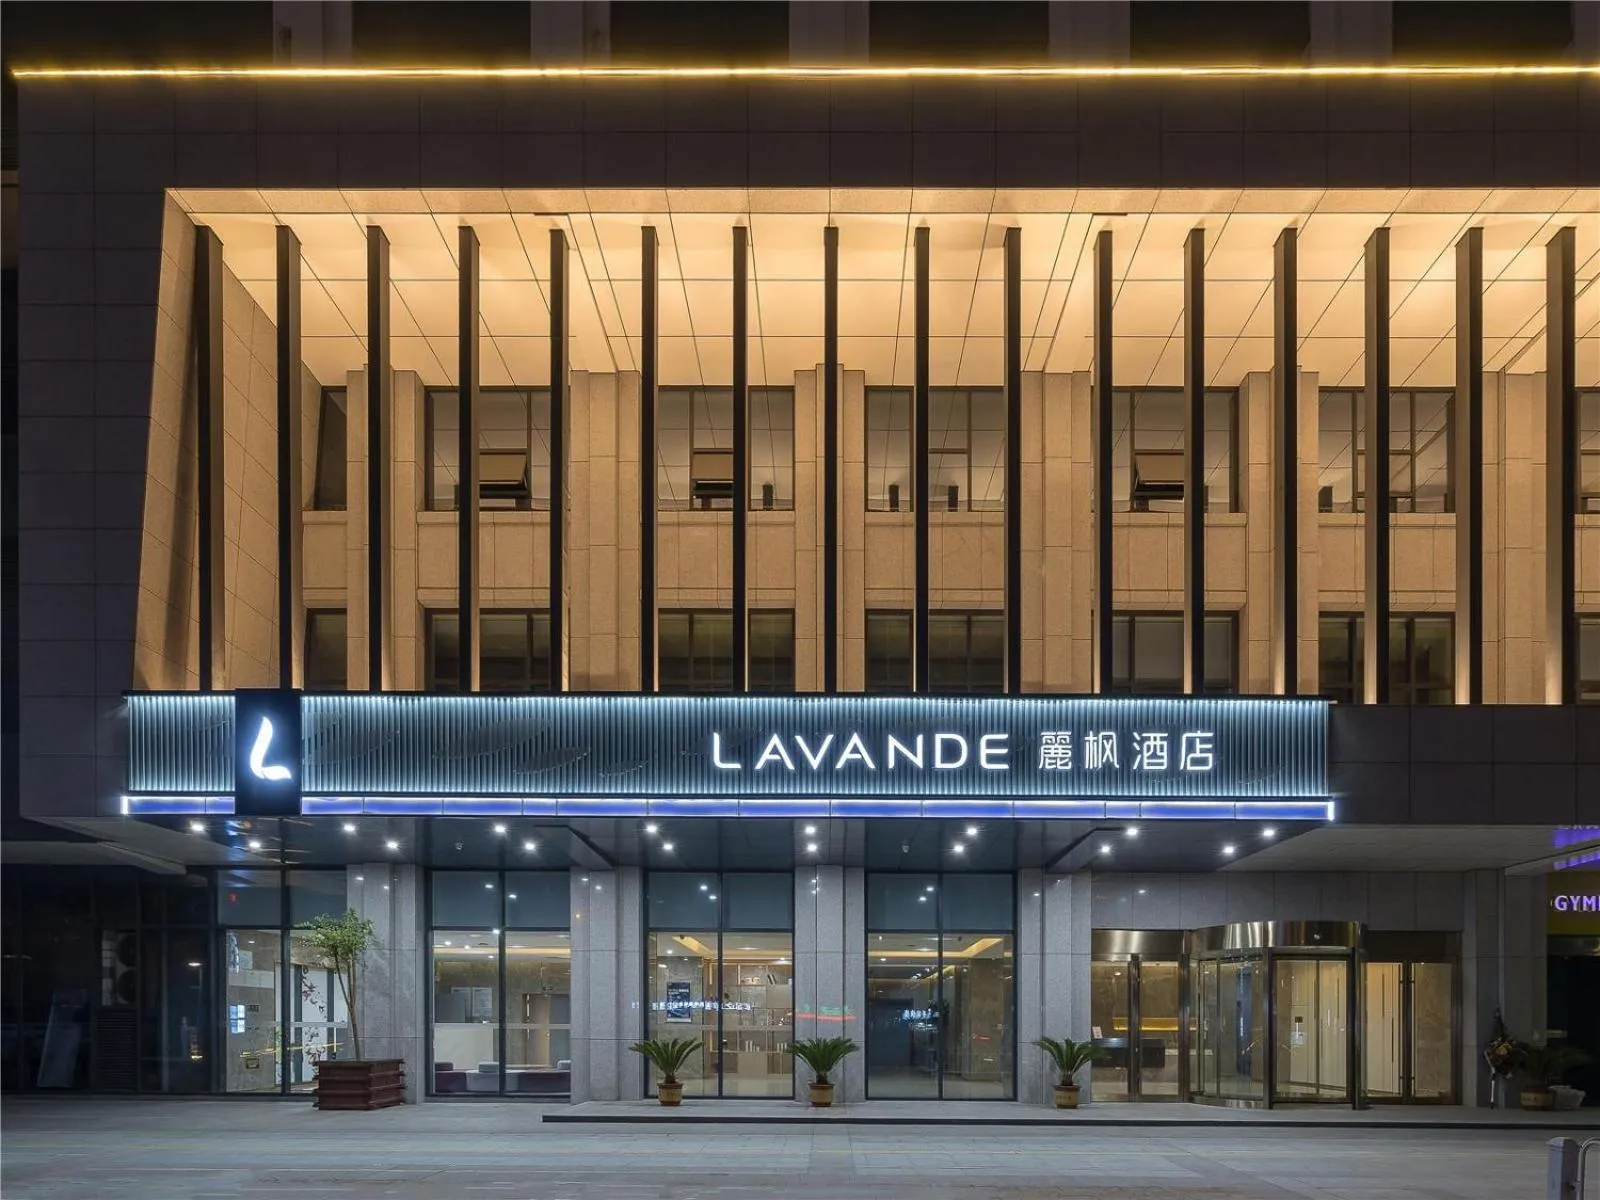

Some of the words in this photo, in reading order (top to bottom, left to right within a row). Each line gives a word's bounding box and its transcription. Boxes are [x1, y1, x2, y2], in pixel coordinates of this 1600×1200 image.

[712, 732, 1010, 770] LAVANDE
[1038, 730, 1215, 771] 麗枫酒店
[1554, 895, 1600, 911] GYM
